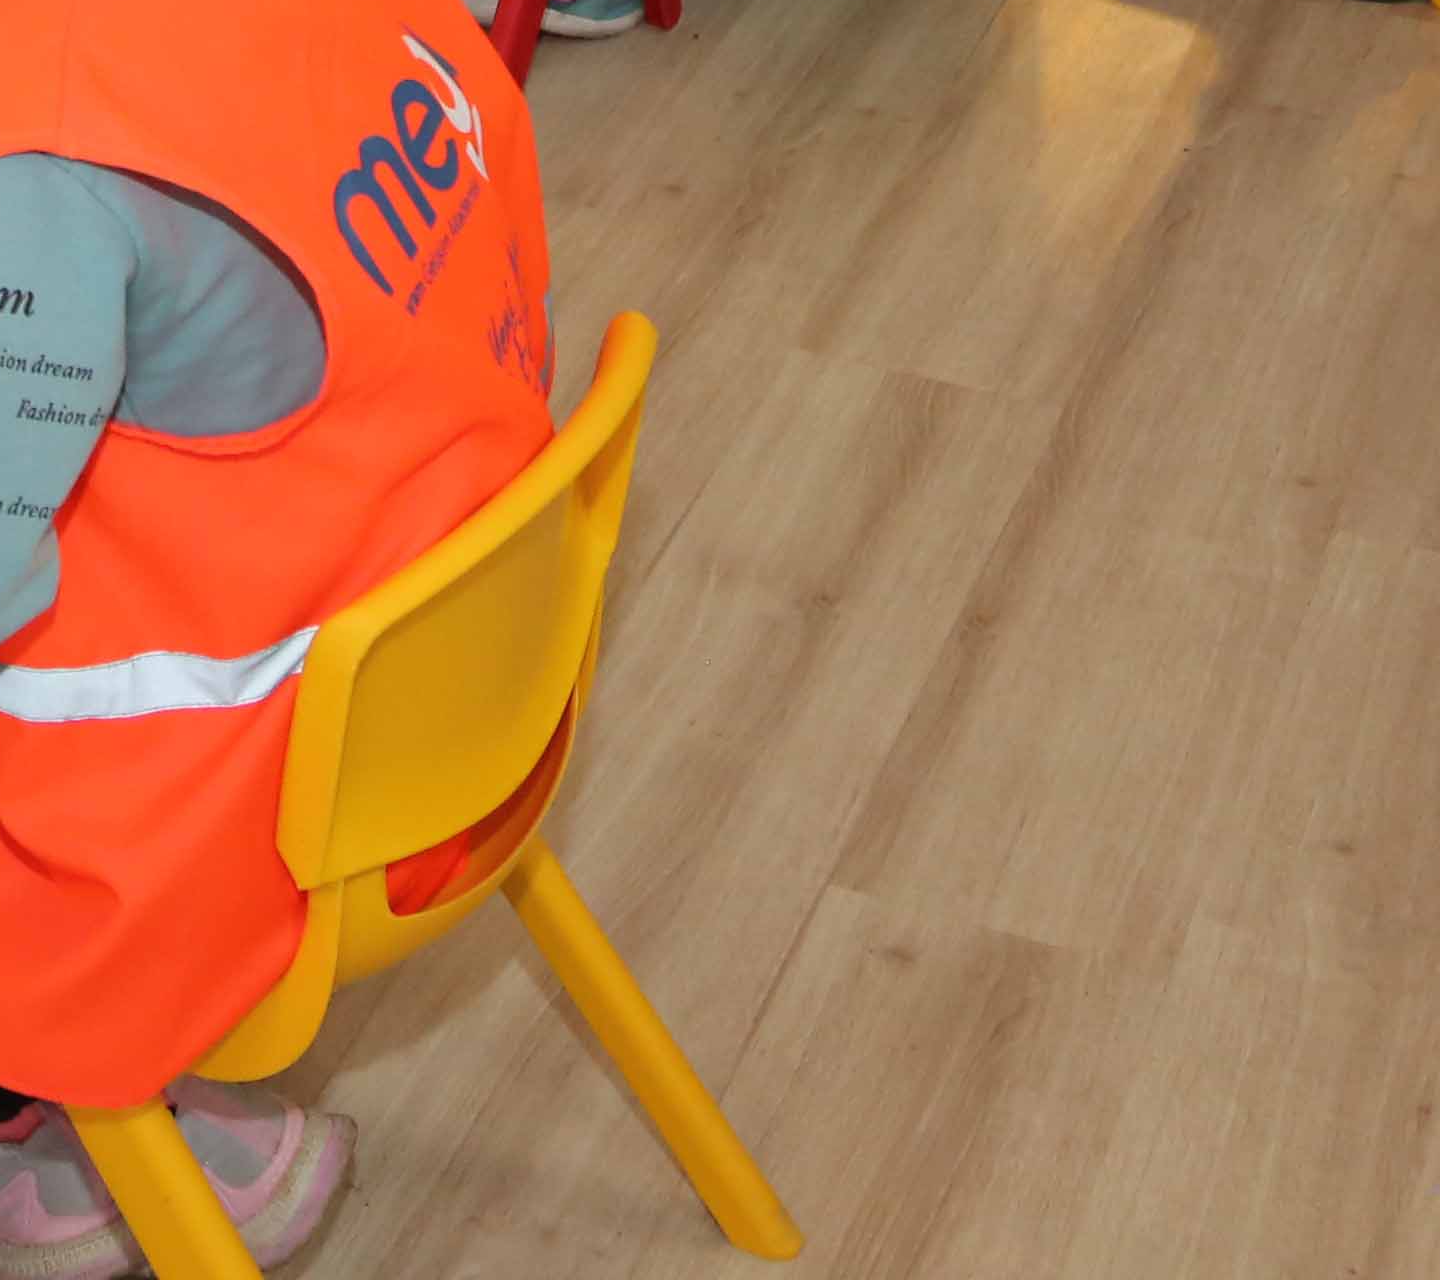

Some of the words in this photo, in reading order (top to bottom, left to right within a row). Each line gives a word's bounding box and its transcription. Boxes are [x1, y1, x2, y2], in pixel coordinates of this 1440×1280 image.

[31, 354, 94, 383] dream
[16, 398, 83, 427] Fashion
[7, 495, 60, 521] drea
